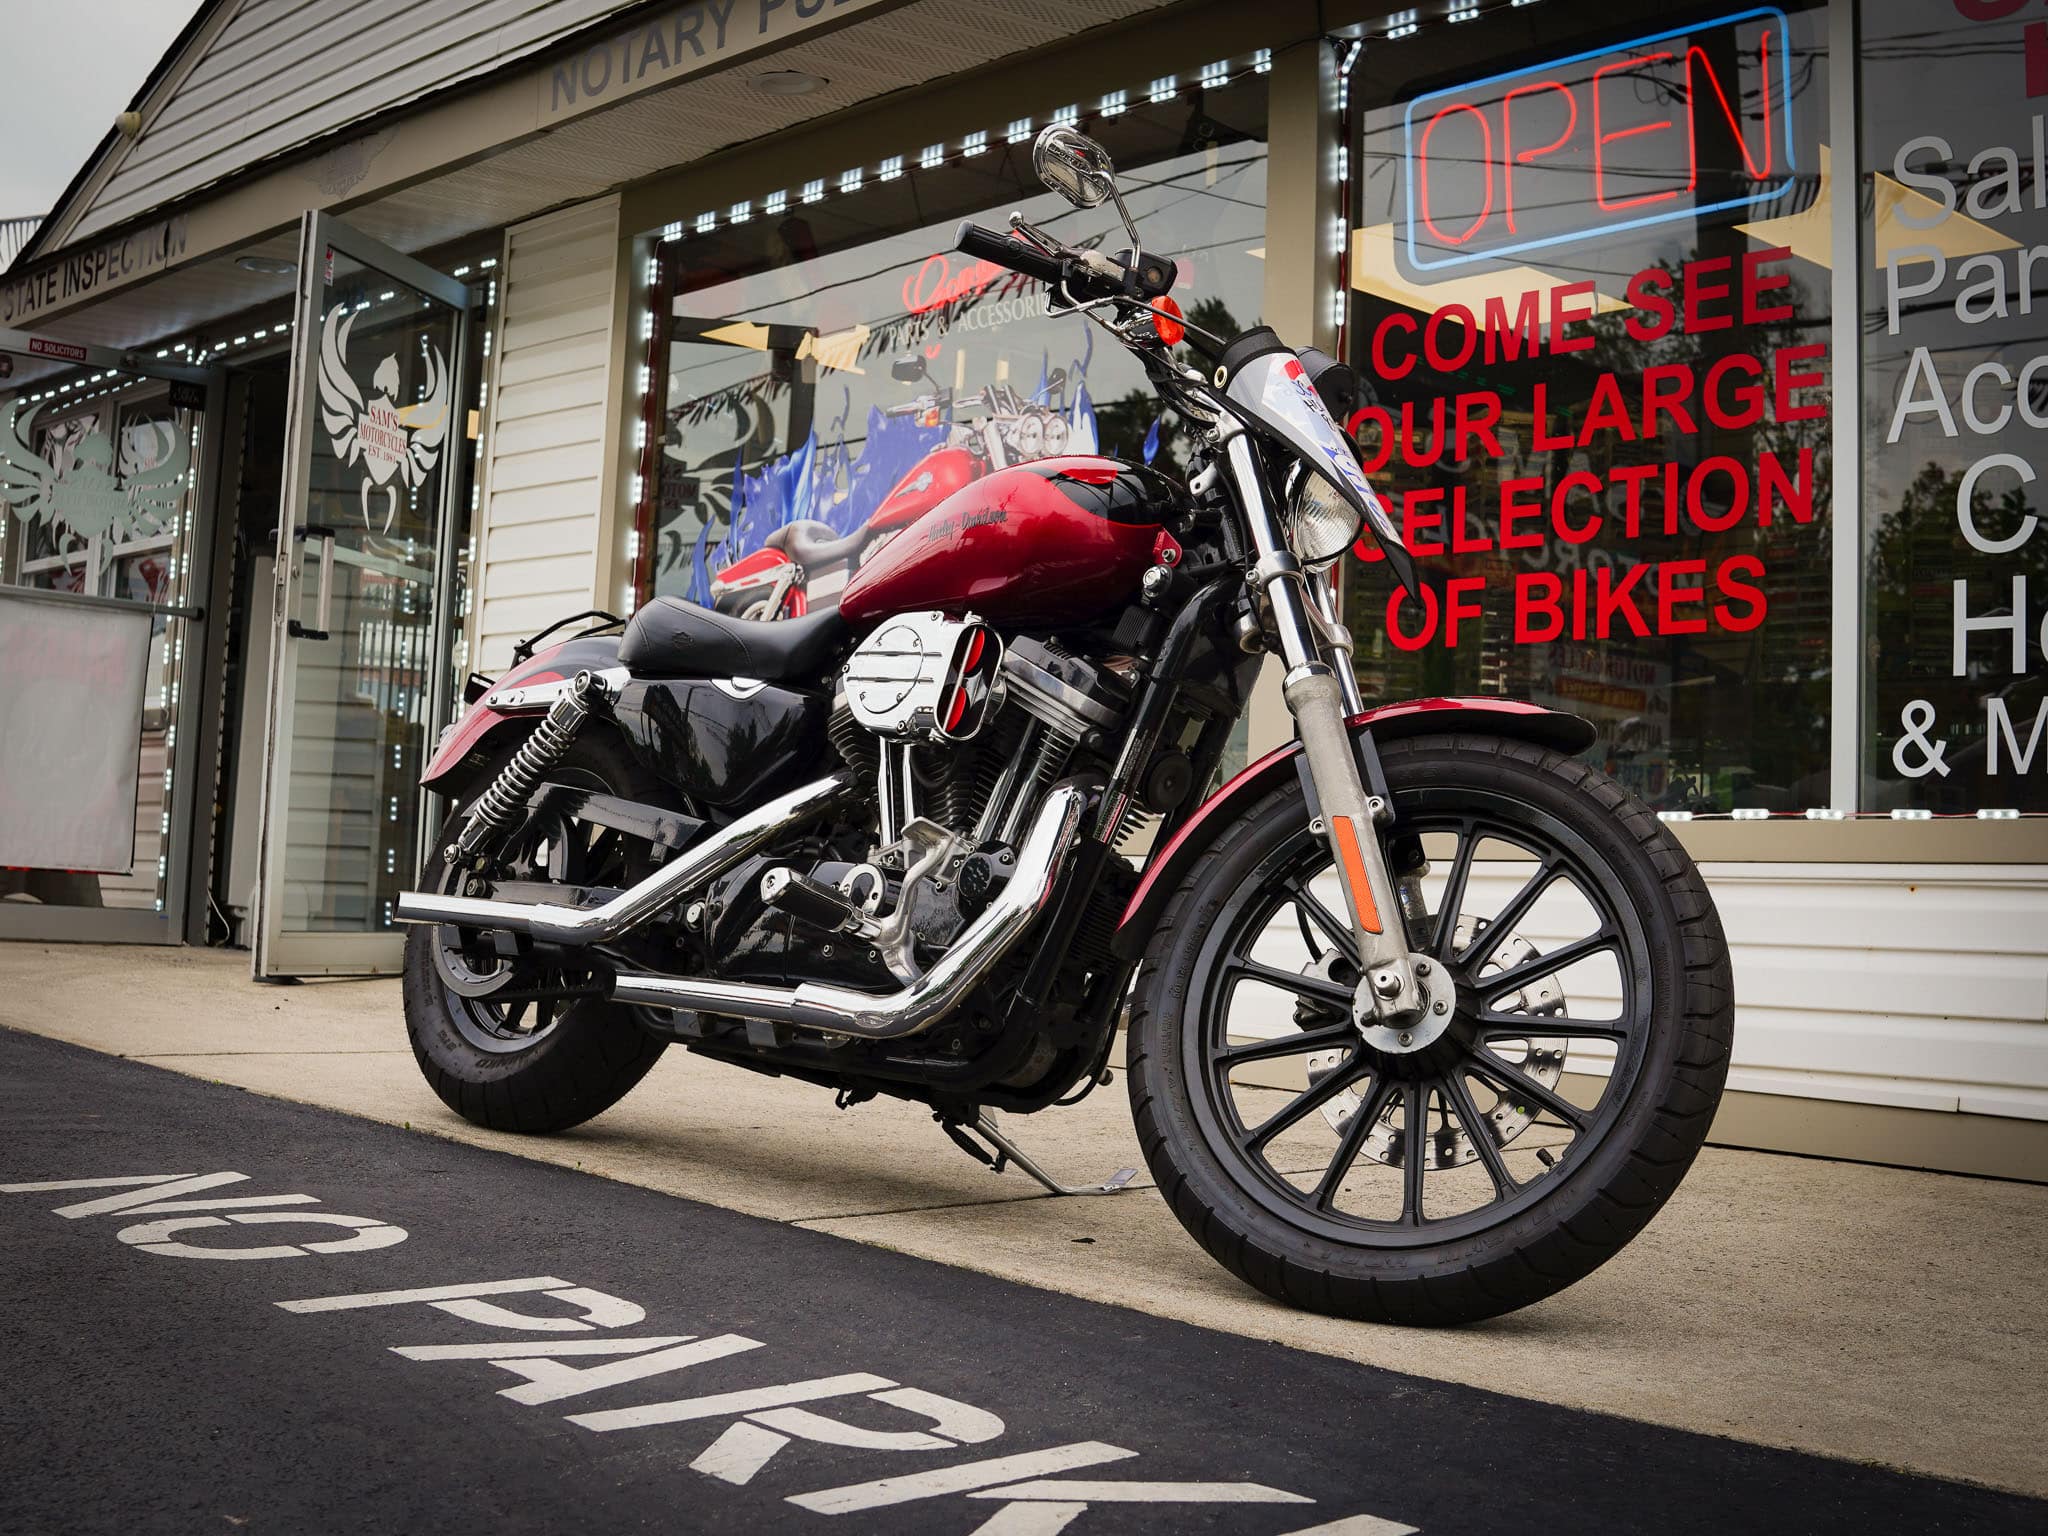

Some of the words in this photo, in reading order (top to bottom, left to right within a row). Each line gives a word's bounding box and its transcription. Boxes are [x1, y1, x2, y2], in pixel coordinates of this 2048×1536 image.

[551, 0, 736, 112] NOTARY
[1420, 30, 1771, 245] OPEN
[4, 266, 58, 321] STATE
[62, 213, 188, 299] INSPECTION
[1371, 280, 1596, 381] COME
[1625, 246, 1794, 342] SEE
[31, 340, 42, 351] NO
[44, 343, 85, 358] SOLICITORS
[889, 318, 930, 348] PARTS
[957, 293, 1056, 333] ACCESSORI
[360, 421, 407, 455] MOTORCYCLES
[370, 407, 397, 431] SAM'S
[1346, 390, 1504, 473] OUR
[1532, 343, 1827, 453] LARGE
[1385, 577, 1487, 652] OF
[1514, 554, 1768, 645] BIKES
[1952, 575, 2048, 677] H
[1892, 699, 1952, 779] &
[0, 1171, 408, 1260] NO
[273, 1275, 1421, 1536] PARK
